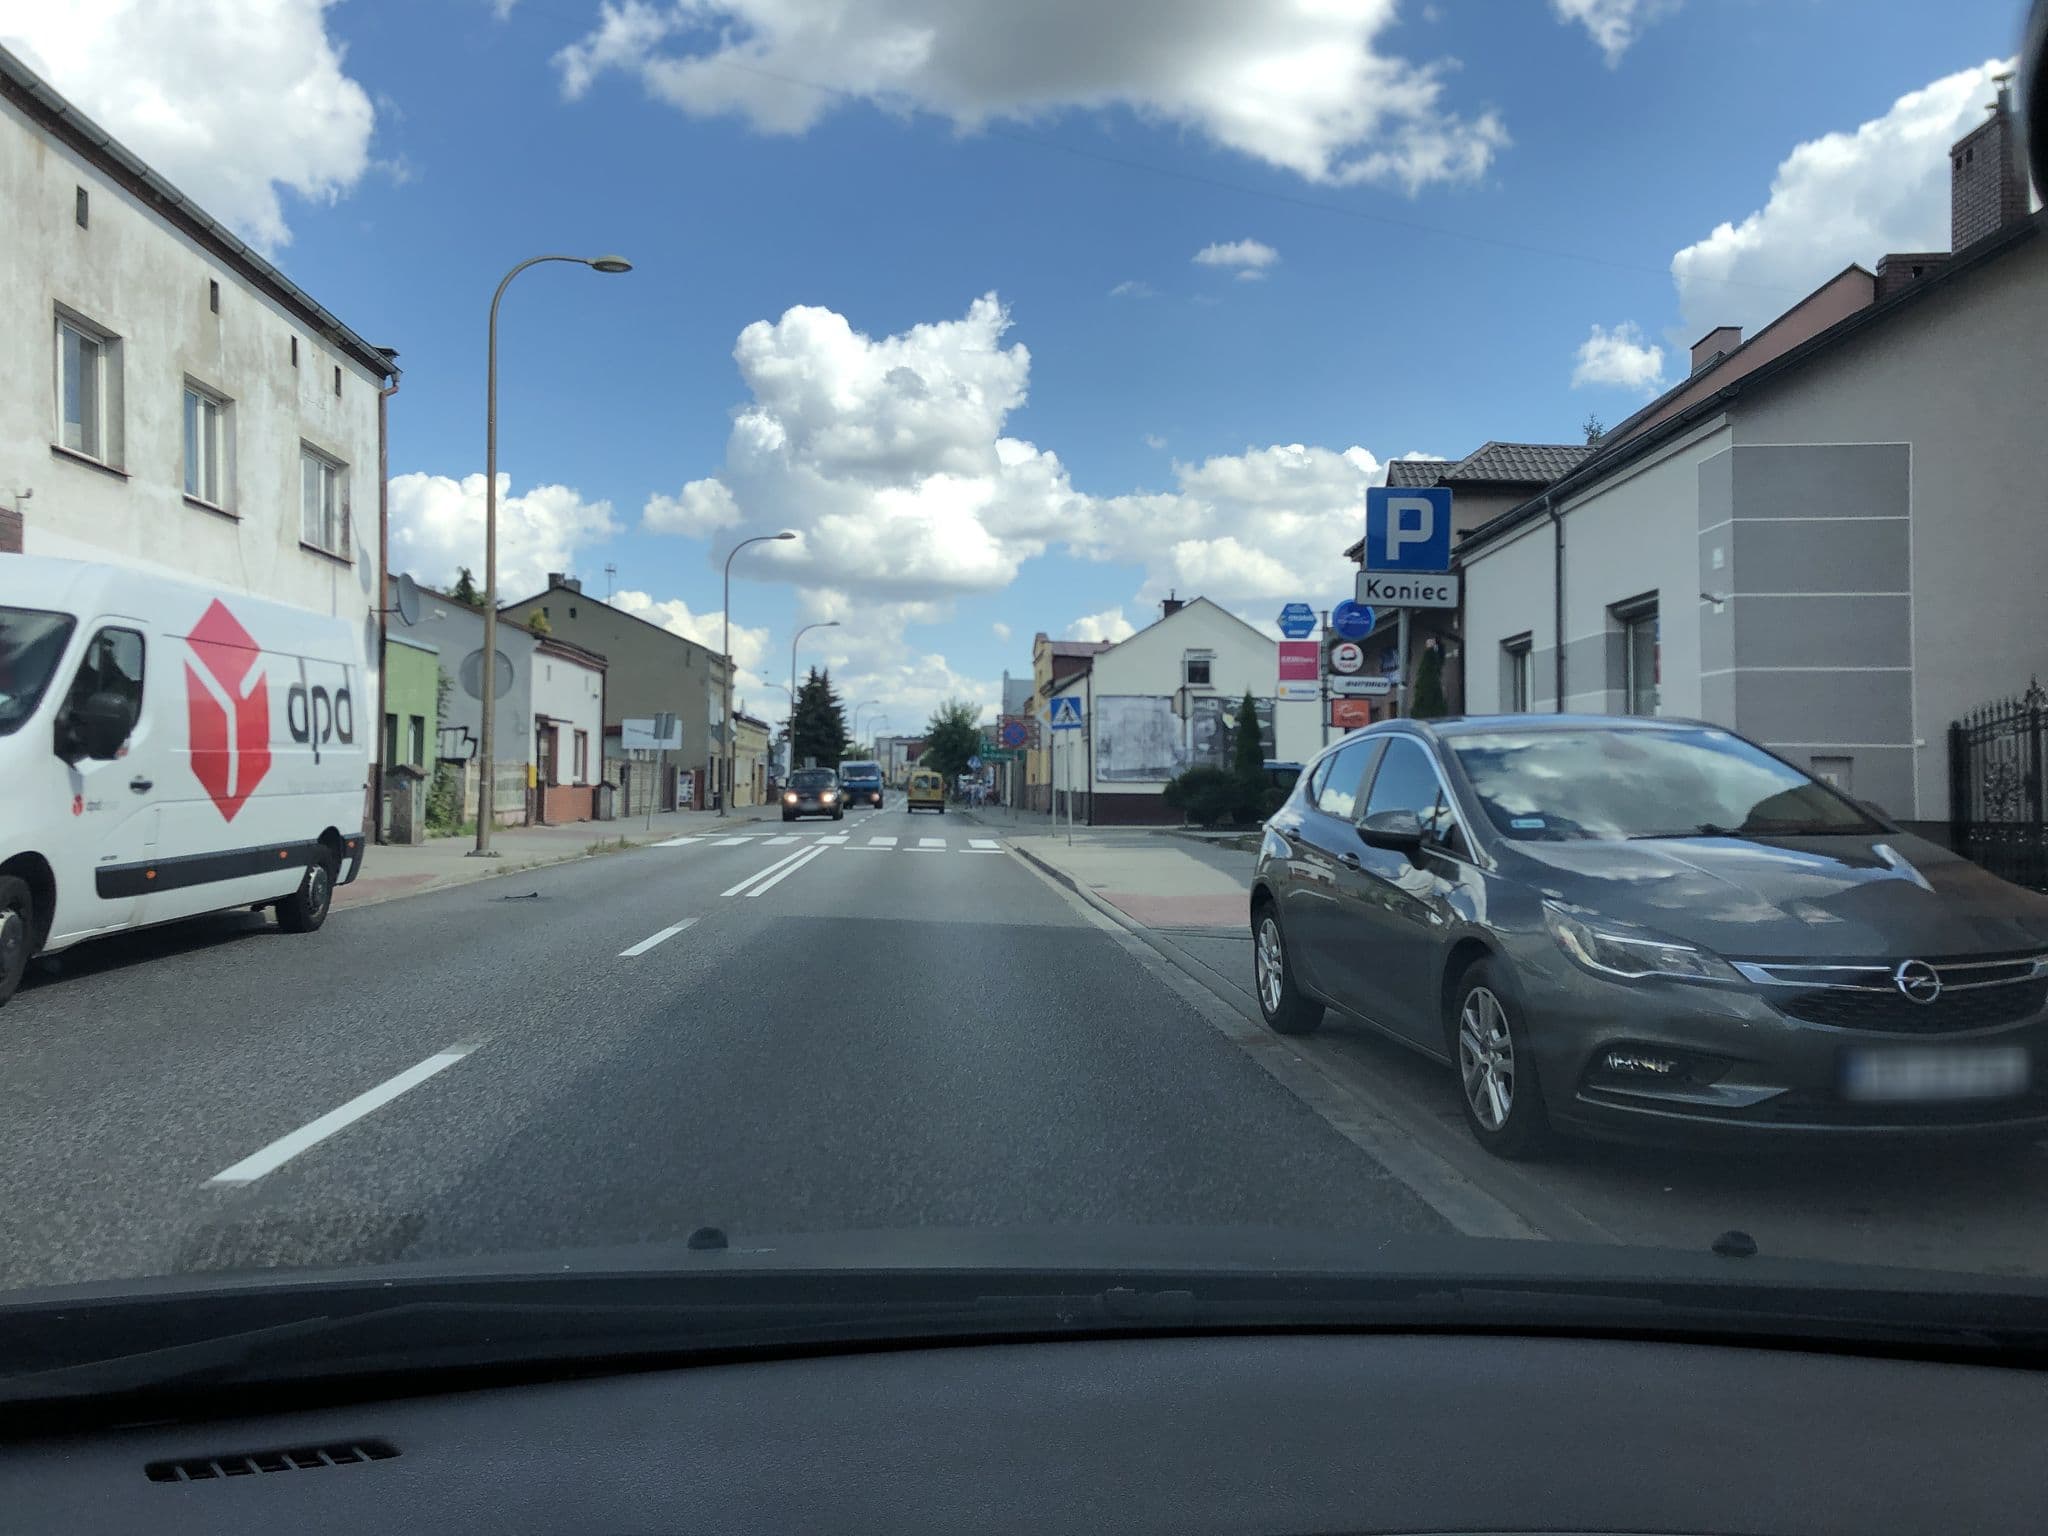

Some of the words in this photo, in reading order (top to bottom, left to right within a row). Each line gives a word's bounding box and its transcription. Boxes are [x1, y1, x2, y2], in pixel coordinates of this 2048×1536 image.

[1386, 497, 1434, 561] P
[1367, 579, 1449, 601] Koniec
[287, 657, 353, 765] dpd
